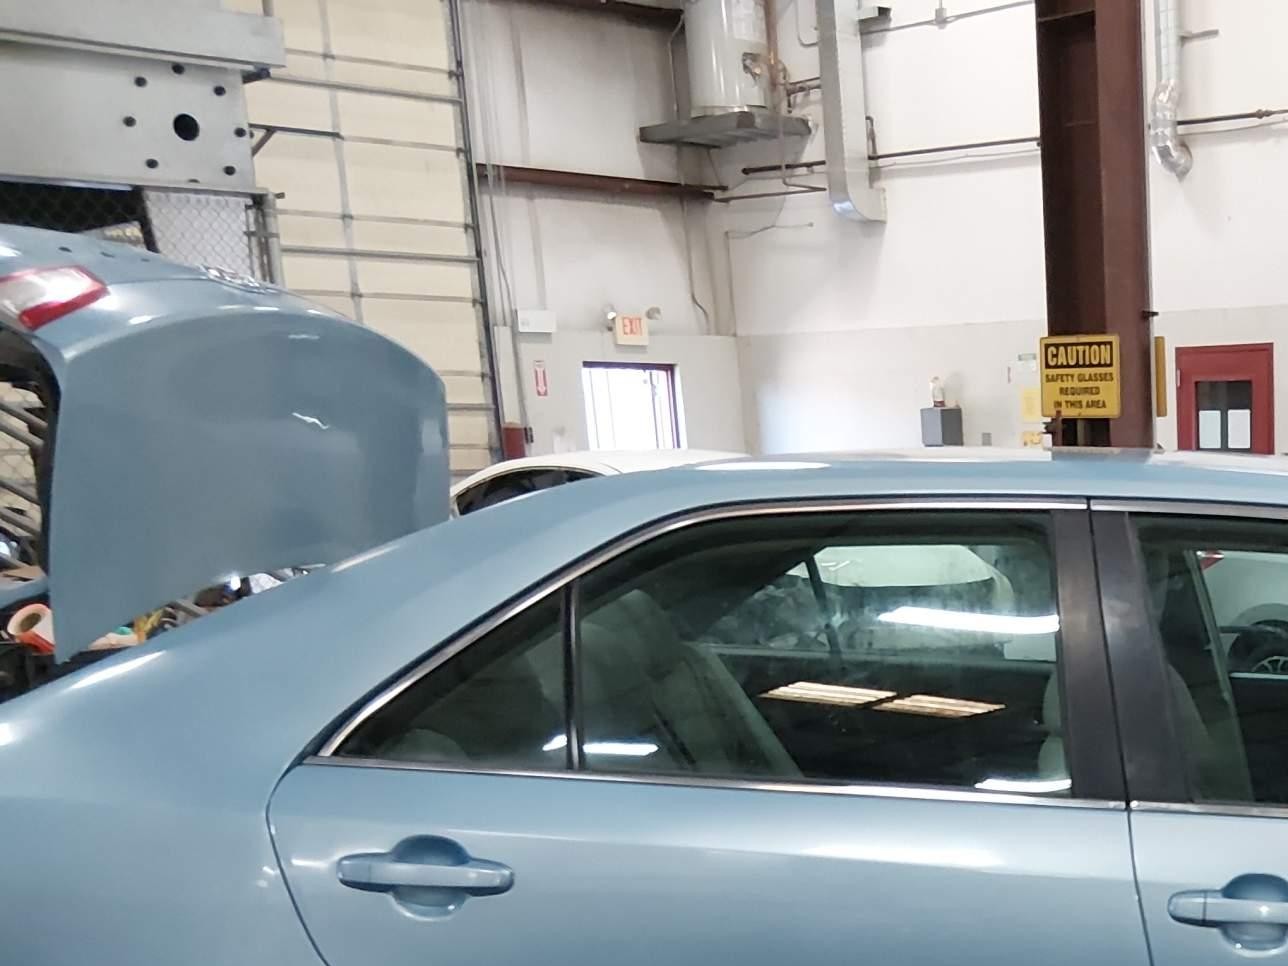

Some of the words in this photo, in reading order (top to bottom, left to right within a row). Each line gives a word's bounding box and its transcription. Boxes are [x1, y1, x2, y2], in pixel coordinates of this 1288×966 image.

[622, 316, 643, 336] EXIT
[1047, 345, 1111, 366] CAUTION
[1046, 374, 1075, 383] SAFETY
[1077, 373, 1114, 382] GLASSES
[1059, 387, 1100, 396] REQUIRED
[1054, 401, 1062, 409] IN
[1065, 400, 1083, 409] THIS
[1086, 400, 1107, 409] AREA
